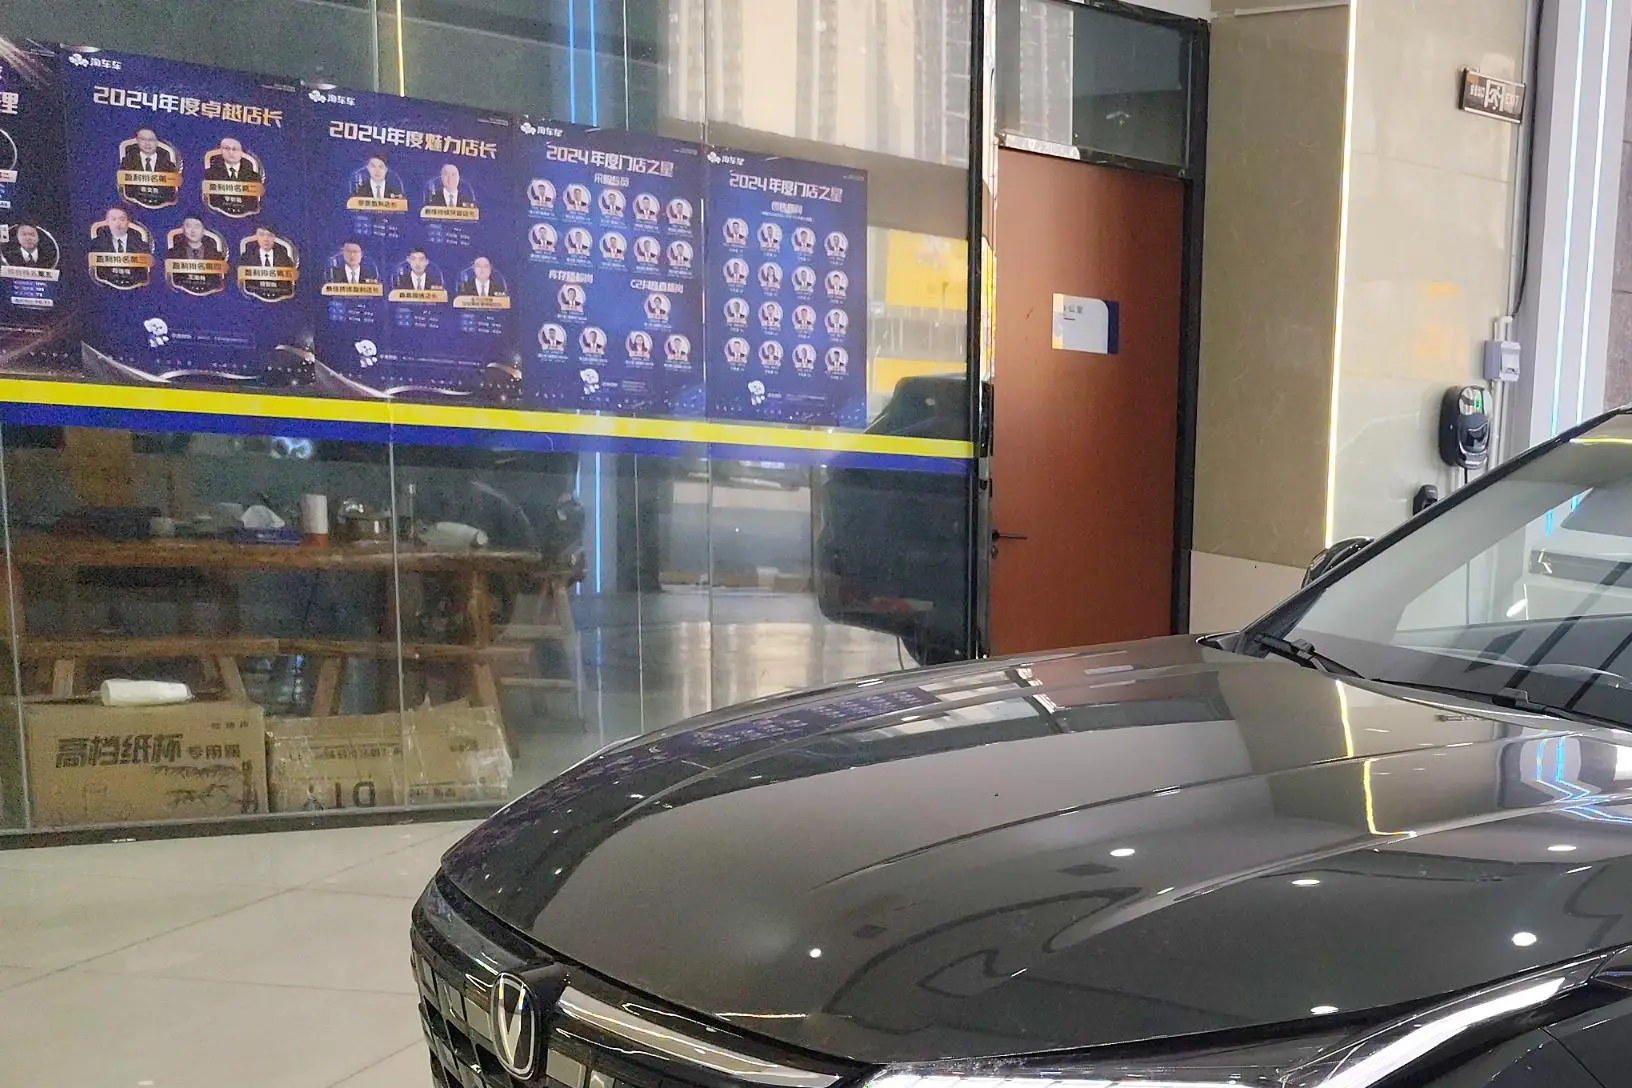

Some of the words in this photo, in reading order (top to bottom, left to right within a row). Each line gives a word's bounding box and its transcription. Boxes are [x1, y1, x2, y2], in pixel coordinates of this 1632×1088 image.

[93, 85, 283, 127] 2024年度卓越店长
[329, 120, 497, 159] 2024年度魅力店长
[56, 733, 184, 768] 高档纸杯
